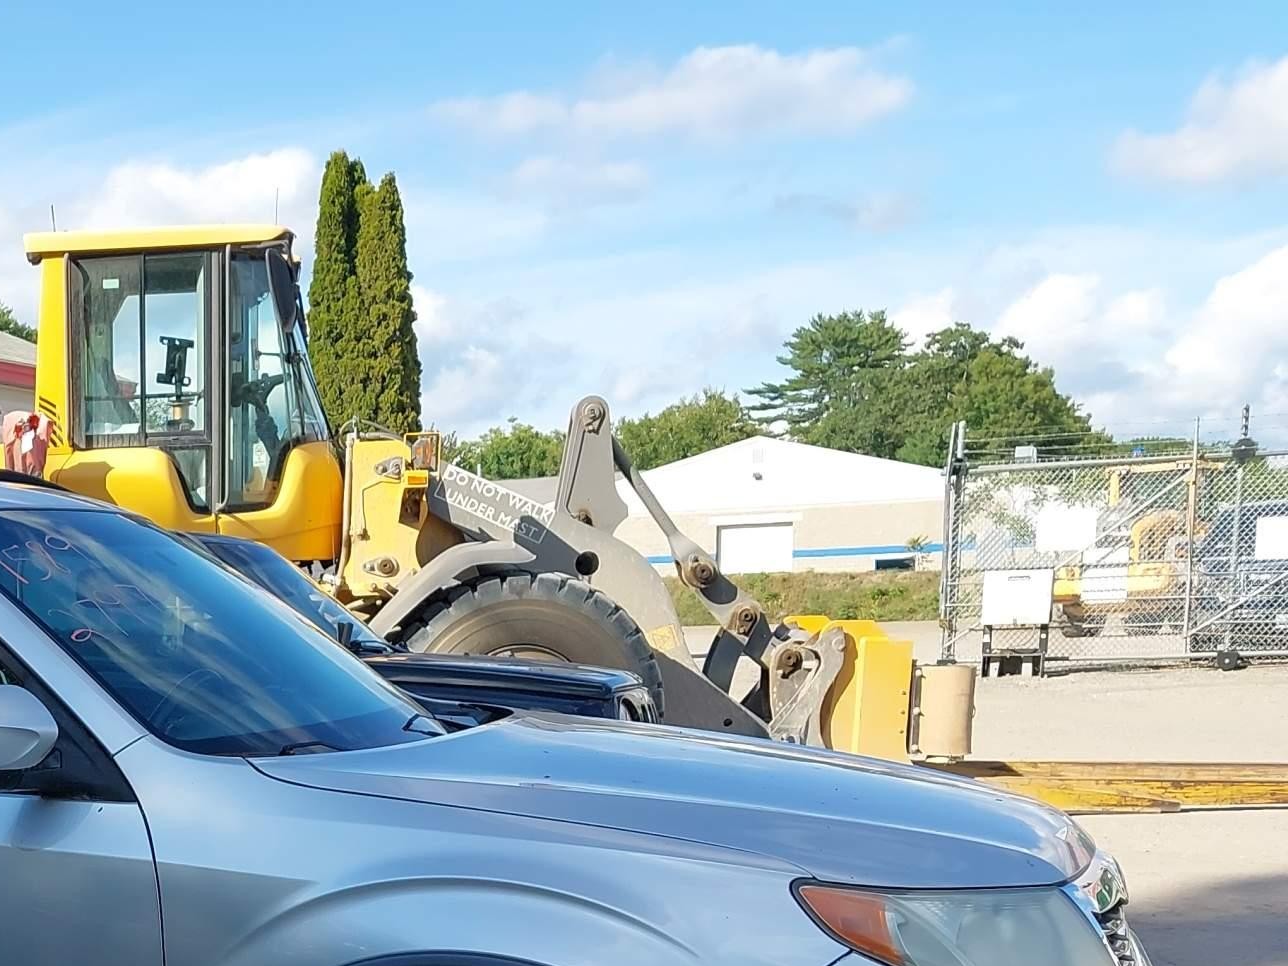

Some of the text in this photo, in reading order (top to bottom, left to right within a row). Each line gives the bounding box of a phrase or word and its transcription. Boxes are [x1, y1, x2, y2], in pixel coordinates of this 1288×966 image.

[444, 467, 551, 521] DO NOT WALK
[447, 488, 539, 537] UNDER MAST
